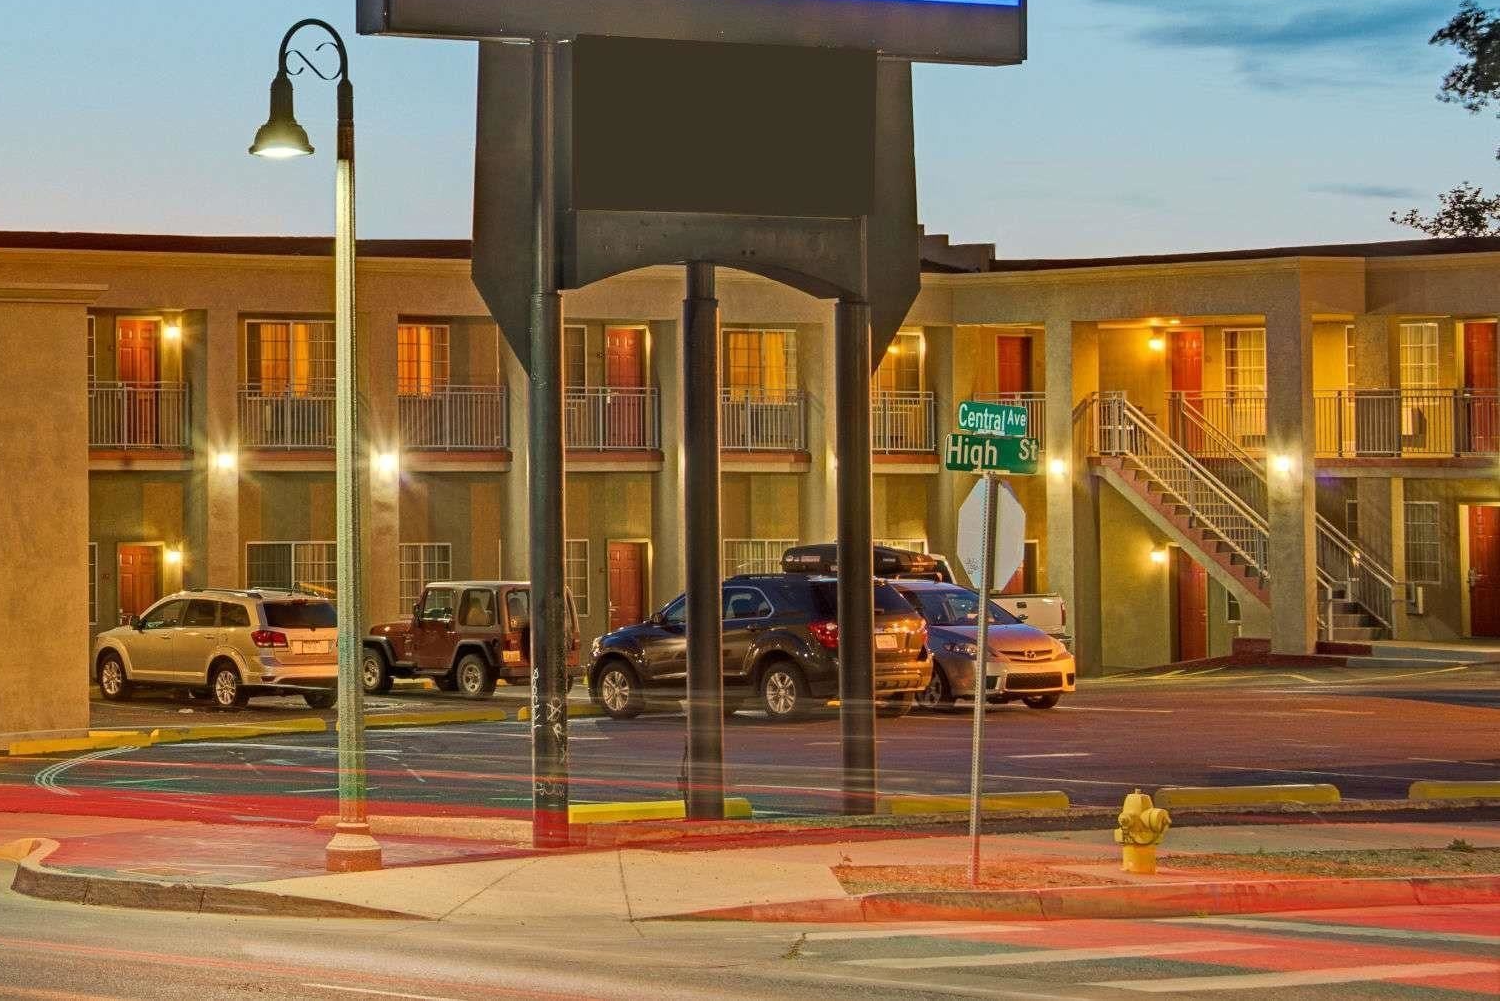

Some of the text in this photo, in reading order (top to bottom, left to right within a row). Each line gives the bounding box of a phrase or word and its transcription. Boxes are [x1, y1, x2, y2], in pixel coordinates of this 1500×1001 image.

[959, 403, 1027, 431] Central Ave
[947, 435, 1038, 469] High St
